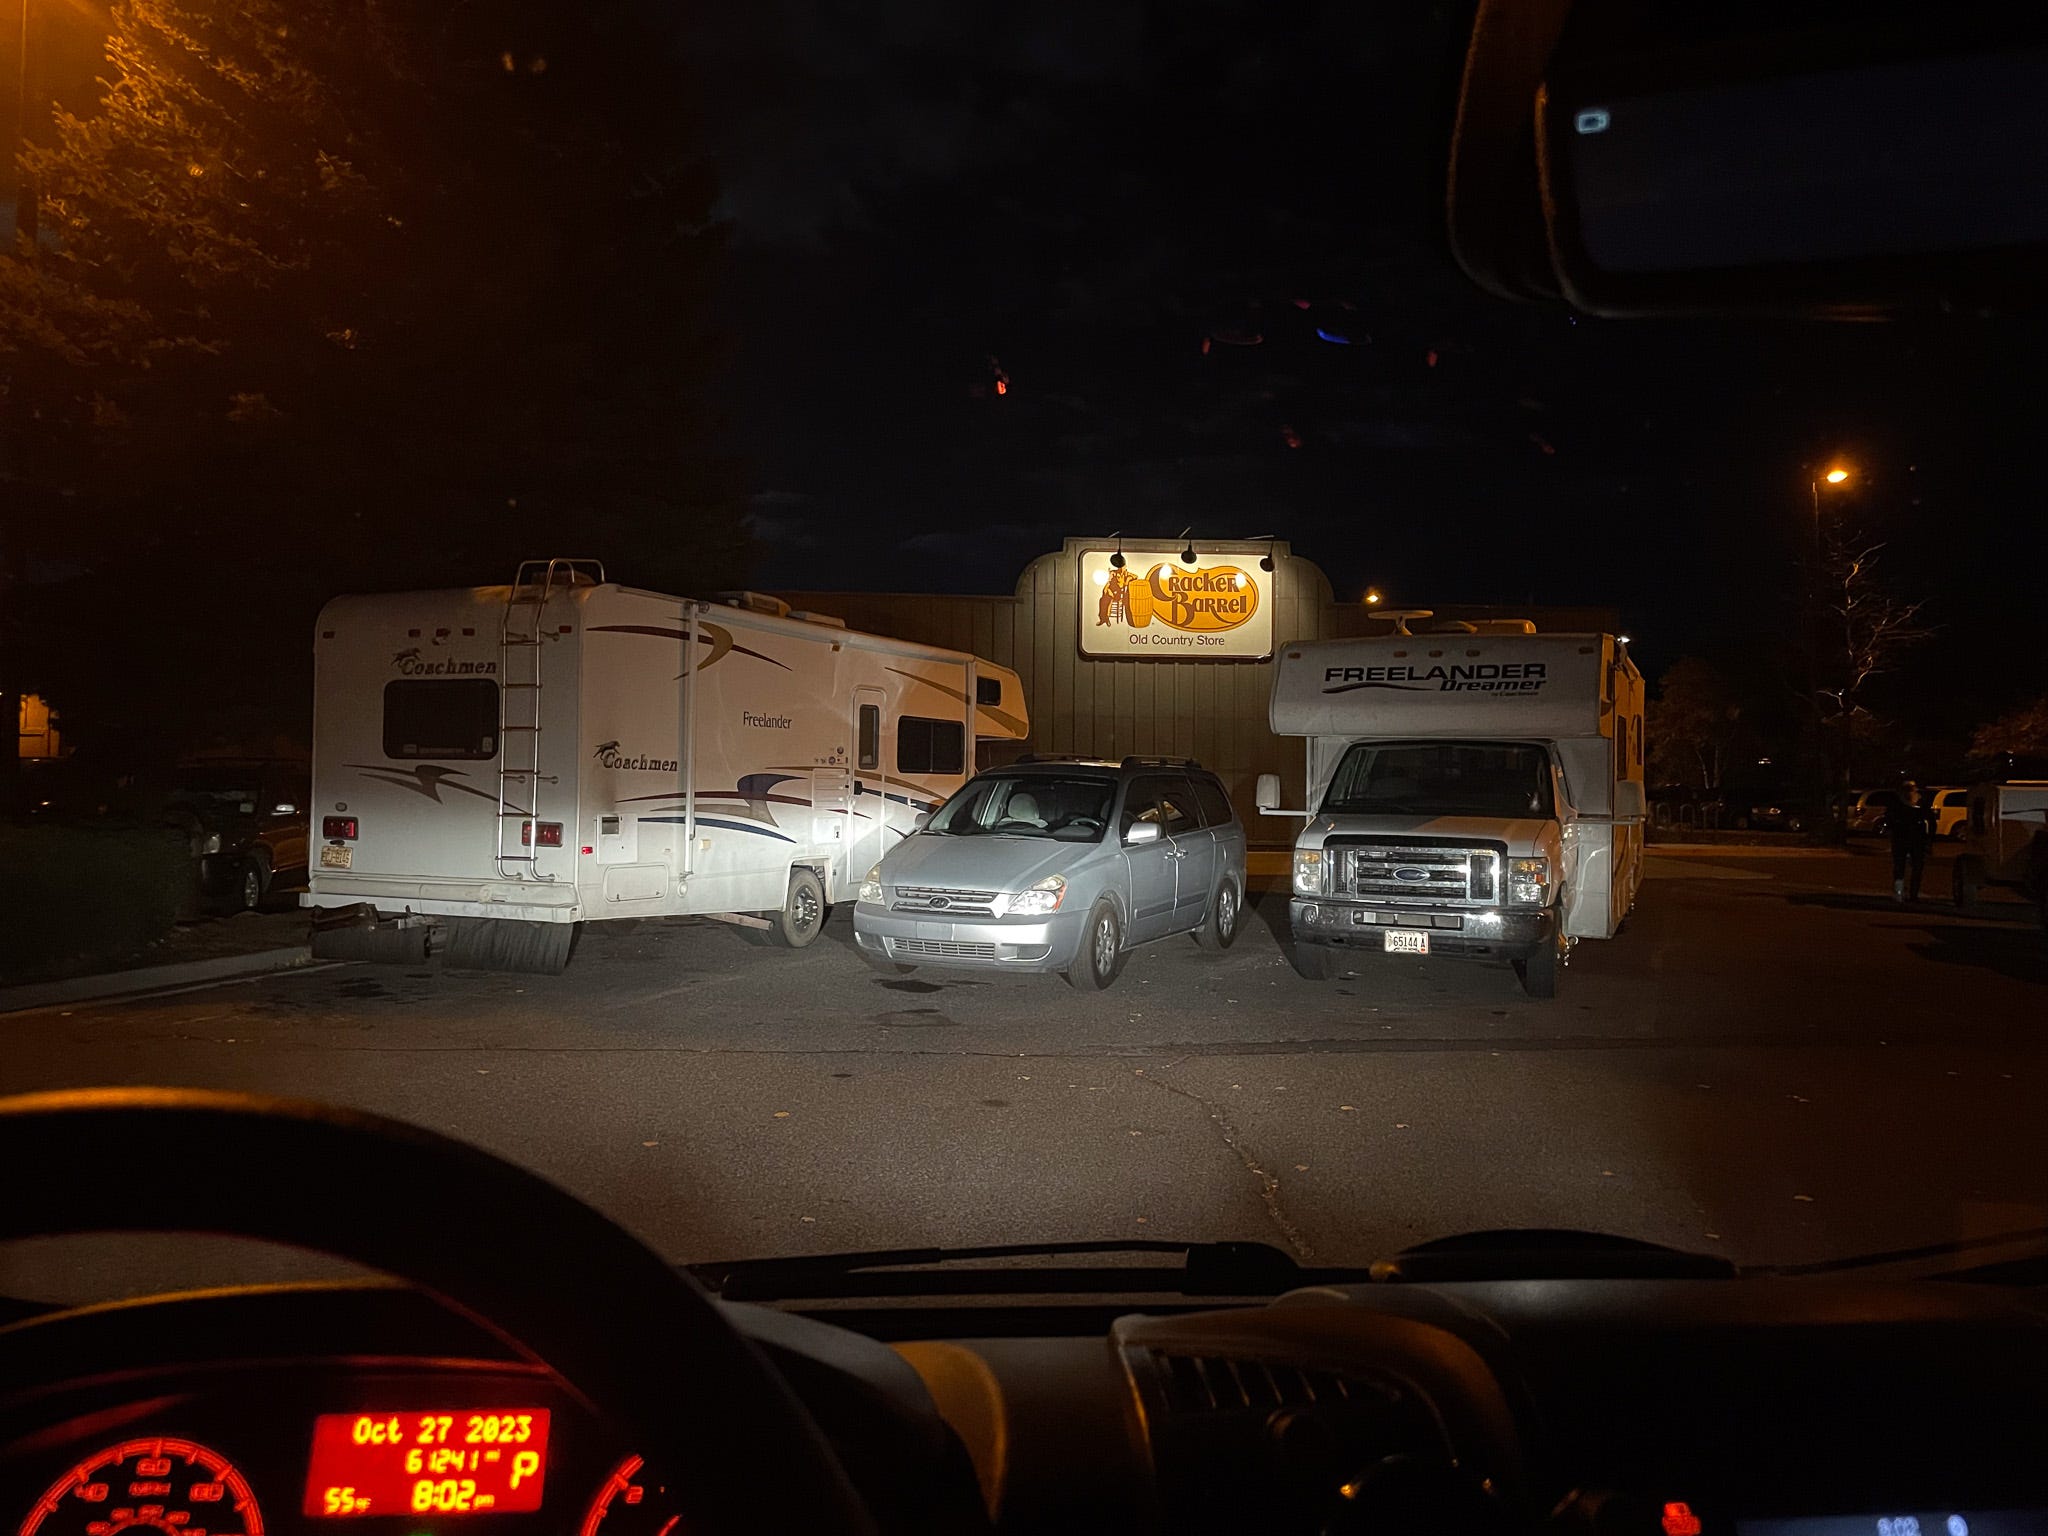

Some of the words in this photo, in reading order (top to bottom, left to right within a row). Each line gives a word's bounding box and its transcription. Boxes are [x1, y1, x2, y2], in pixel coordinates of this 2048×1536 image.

[1149, 567, 1240, 601] Cracker
[1172, 592, 1247, 627] Barrel
[1129, 634, 1148, 645] Old
[1151, 634, 1194, 646] Country
[1196, 635, 1225, 646] Store
[400, 658, 497, 676] Coachmen
[1325, 664, 1546, 682] FREELANDER
[1439, 679, 1547, 692] Dreamer
[743, 711, 792, 729] Freelander
[602, 752, 678, 773] Coachmen
[1393, 936, 1418, 947] 65144
[352, 1416, 403, 1445] Oct
[416, 1416, 454, 1444] 27
[465, 1415, 532, 1444] 2023
[405, 1448, 480, 1475] 61241
[509, 1450, 540, 1490] P
